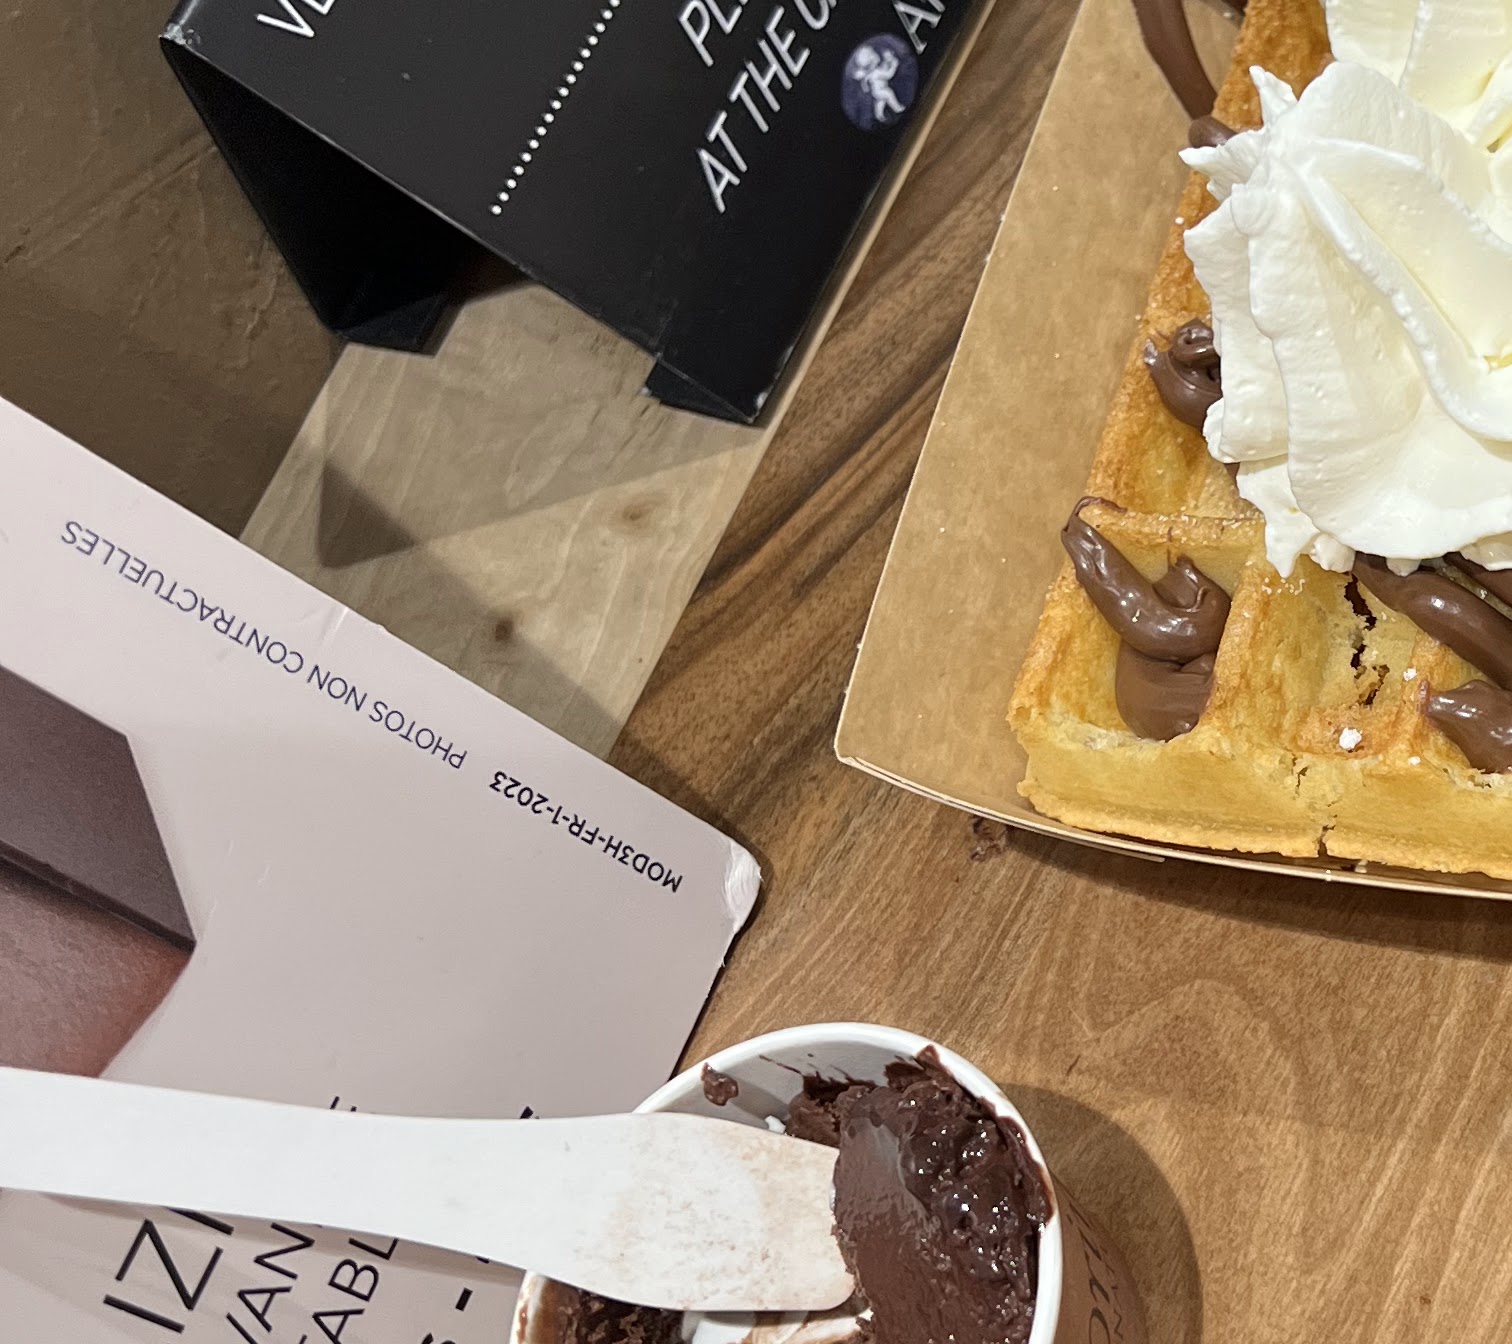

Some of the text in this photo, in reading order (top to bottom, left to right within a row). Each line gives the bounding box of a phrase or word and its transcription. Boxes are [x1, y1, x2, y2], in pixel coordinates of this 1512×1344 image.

[697, 110, 754, 213] AT
[729, 6, 812, 134] THE
[60, 520, 468, 770] PHOTOS NON CONTRACTUELLES
[488, 770, 683, 893] MOD3H-FR-1-2023
